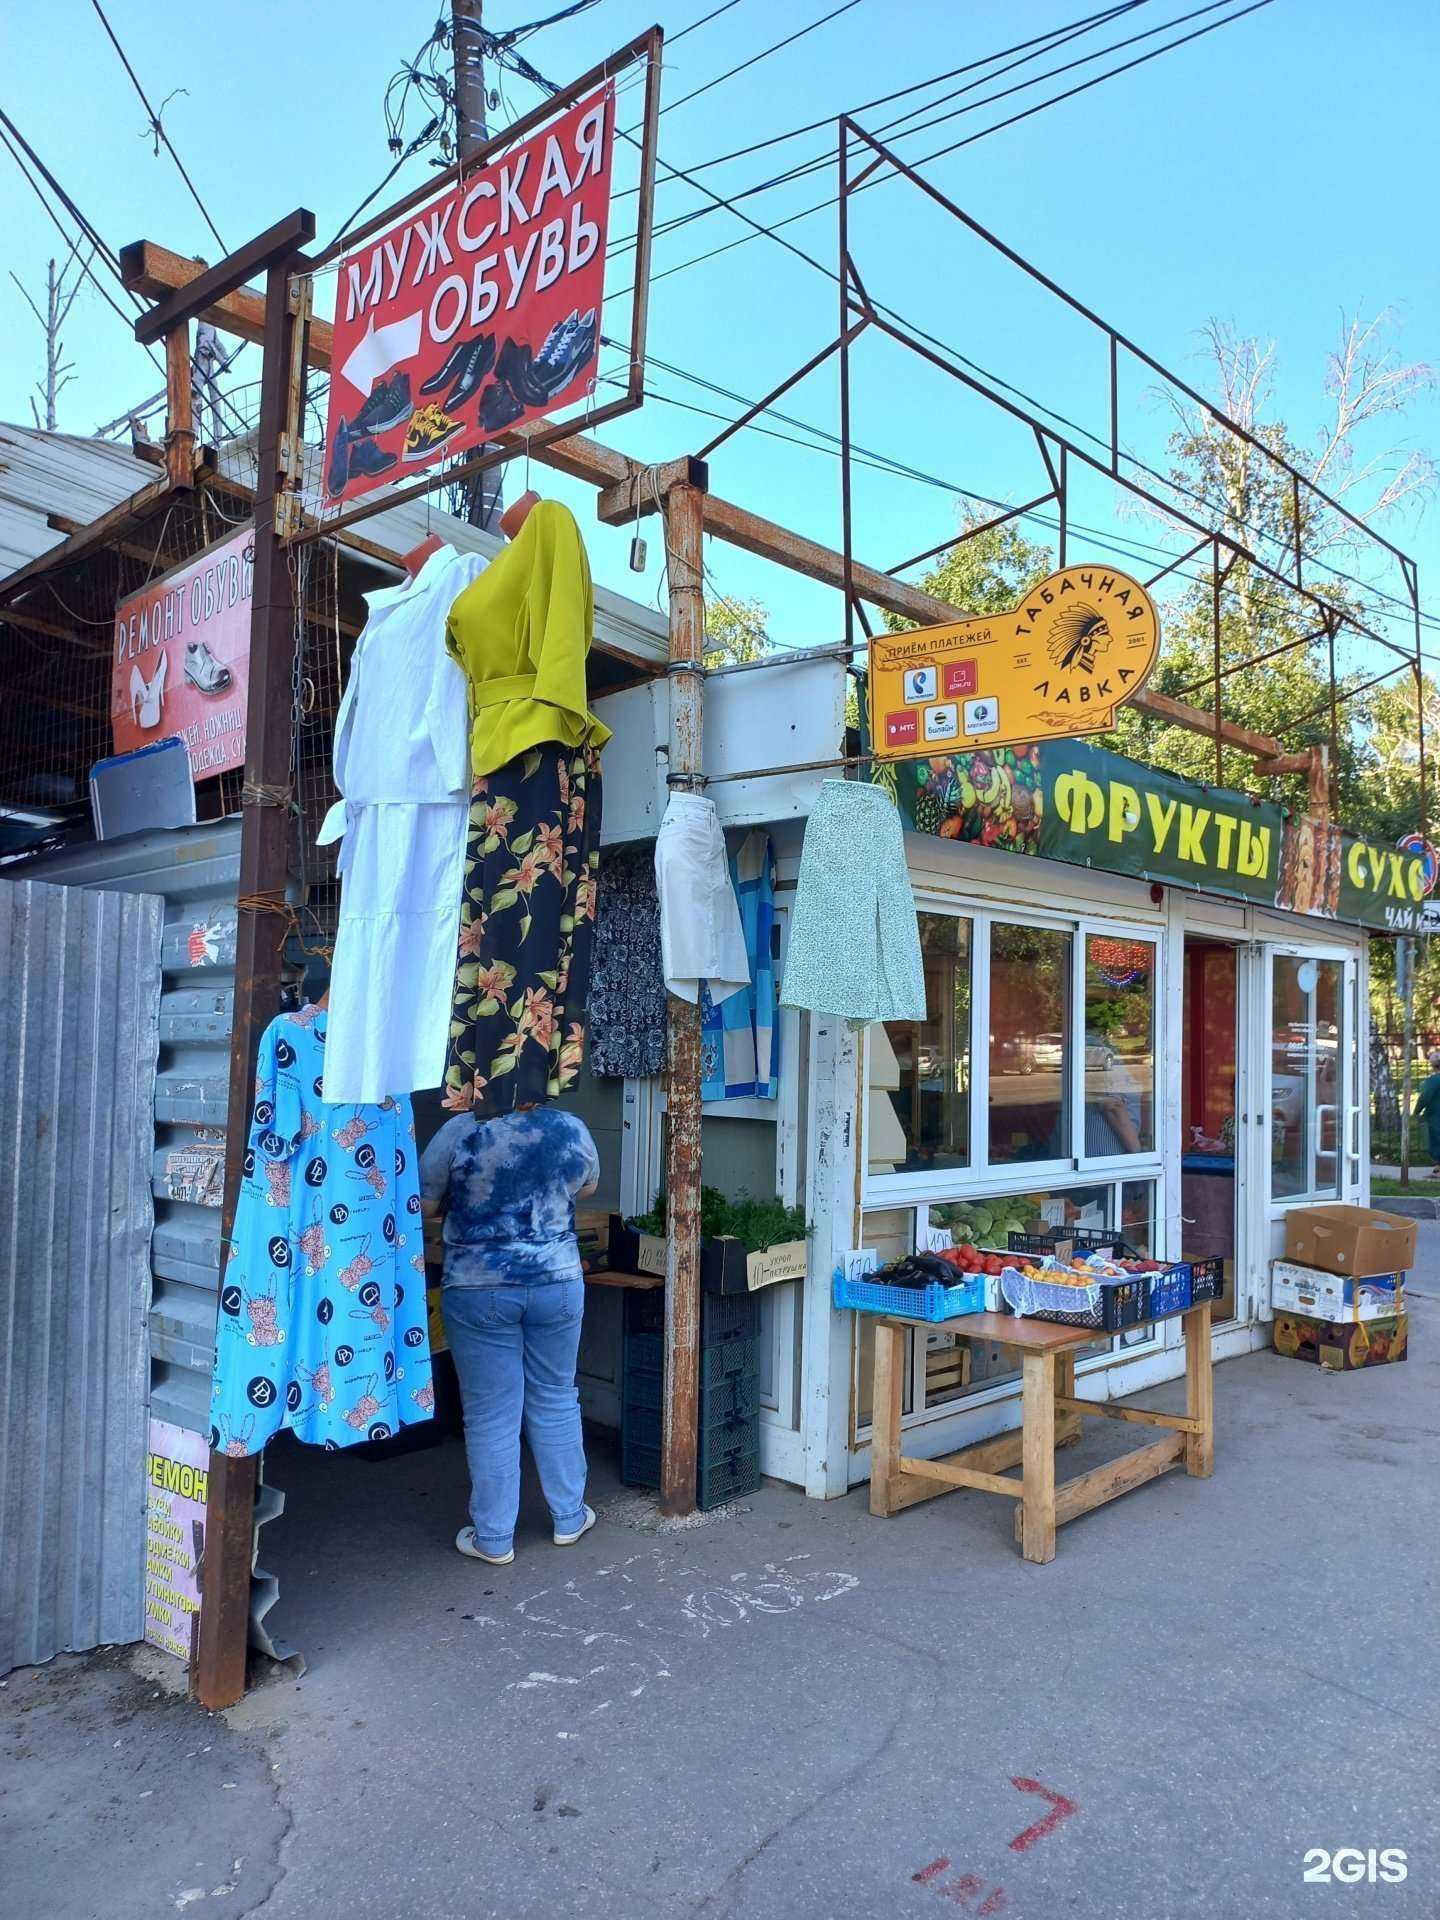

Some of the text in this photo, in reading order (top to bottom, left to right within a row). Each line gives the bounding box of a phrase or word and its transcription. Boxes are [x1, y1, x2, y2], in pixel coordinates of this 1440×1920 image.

[345, 101, 606, 322] МУЖСКАЯ
[428, 201, 600, 343] ОБУВЬ
[118, 554, 253, 666] РЕМОНТ ОБУВИ
[1015, 573, 1145, 636] ТАБАЧНАЯ
[888, 628, 991, 657] ПРИЁМ ПЛАТЕЖЕЙ
[1034, 668, 1135, 704] ЛАВКА
[899, 723, 916, 733] МТС
[1054, 769, 1271, 880] ФРУКТЫ
[1385, 906, 1413, 930] ЧАЙ
